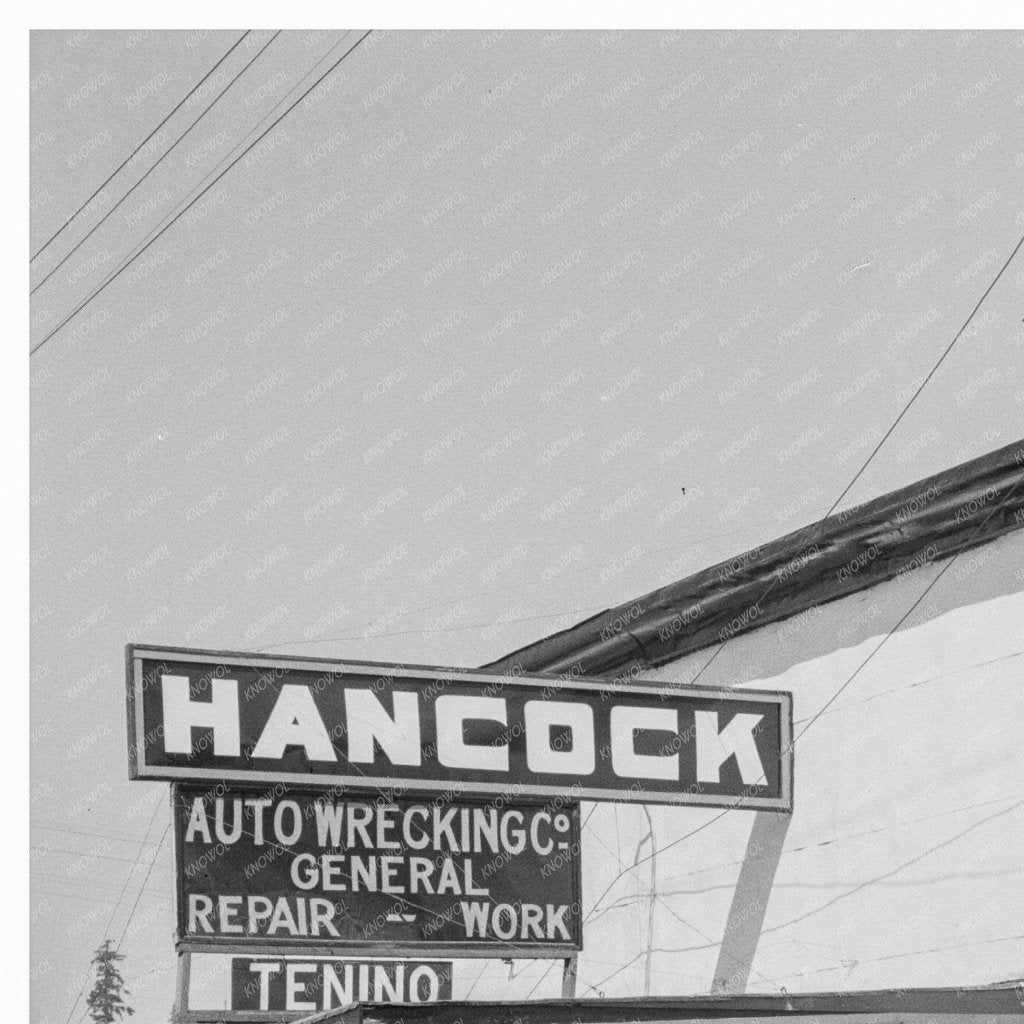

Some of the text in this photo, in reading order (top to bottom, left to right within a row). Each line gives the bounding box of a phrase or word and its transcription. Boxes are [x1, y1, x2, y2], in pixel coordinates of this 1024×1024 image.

[160, 674, 768, 786] HANCOCK
[185, 795, 302, 846] AUTO
[315, 802, 527, 856] WRECKING
[290, 854, 489, 897] GENERAL
[187, 894, 571, 941] REPAIR WORK
[249, 962, 440, 1011] TENINO
